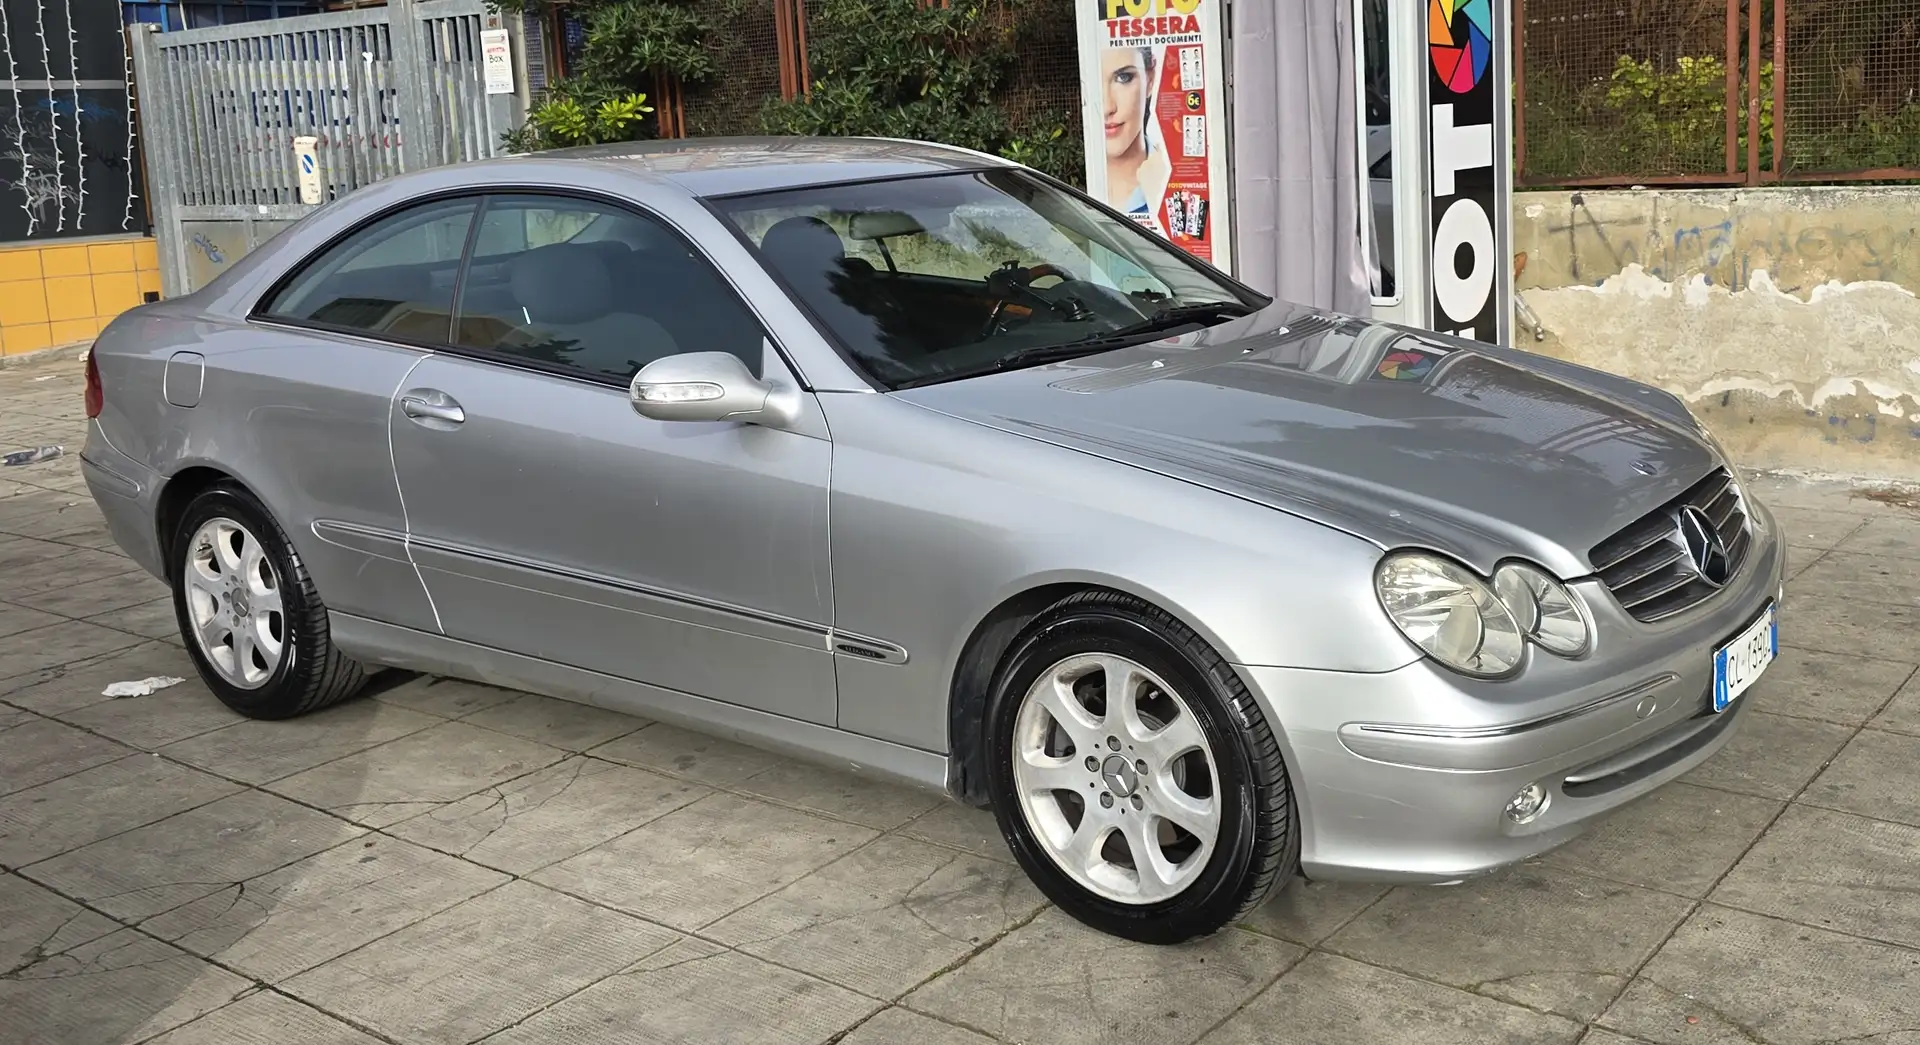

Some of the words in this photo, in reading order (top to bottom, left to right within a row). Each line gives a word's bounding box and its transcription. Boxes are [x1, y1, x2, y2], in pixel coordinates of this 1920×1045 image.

[1106, 15, 1201, 38] TESSERA
[1109, 39, 1123, 47] PER
[1126, 38, 1146, 46] TUTTI
[1155, 34, 1202, 44] DOCUMENTI
[1187, 94, 1200, 106] 6€
